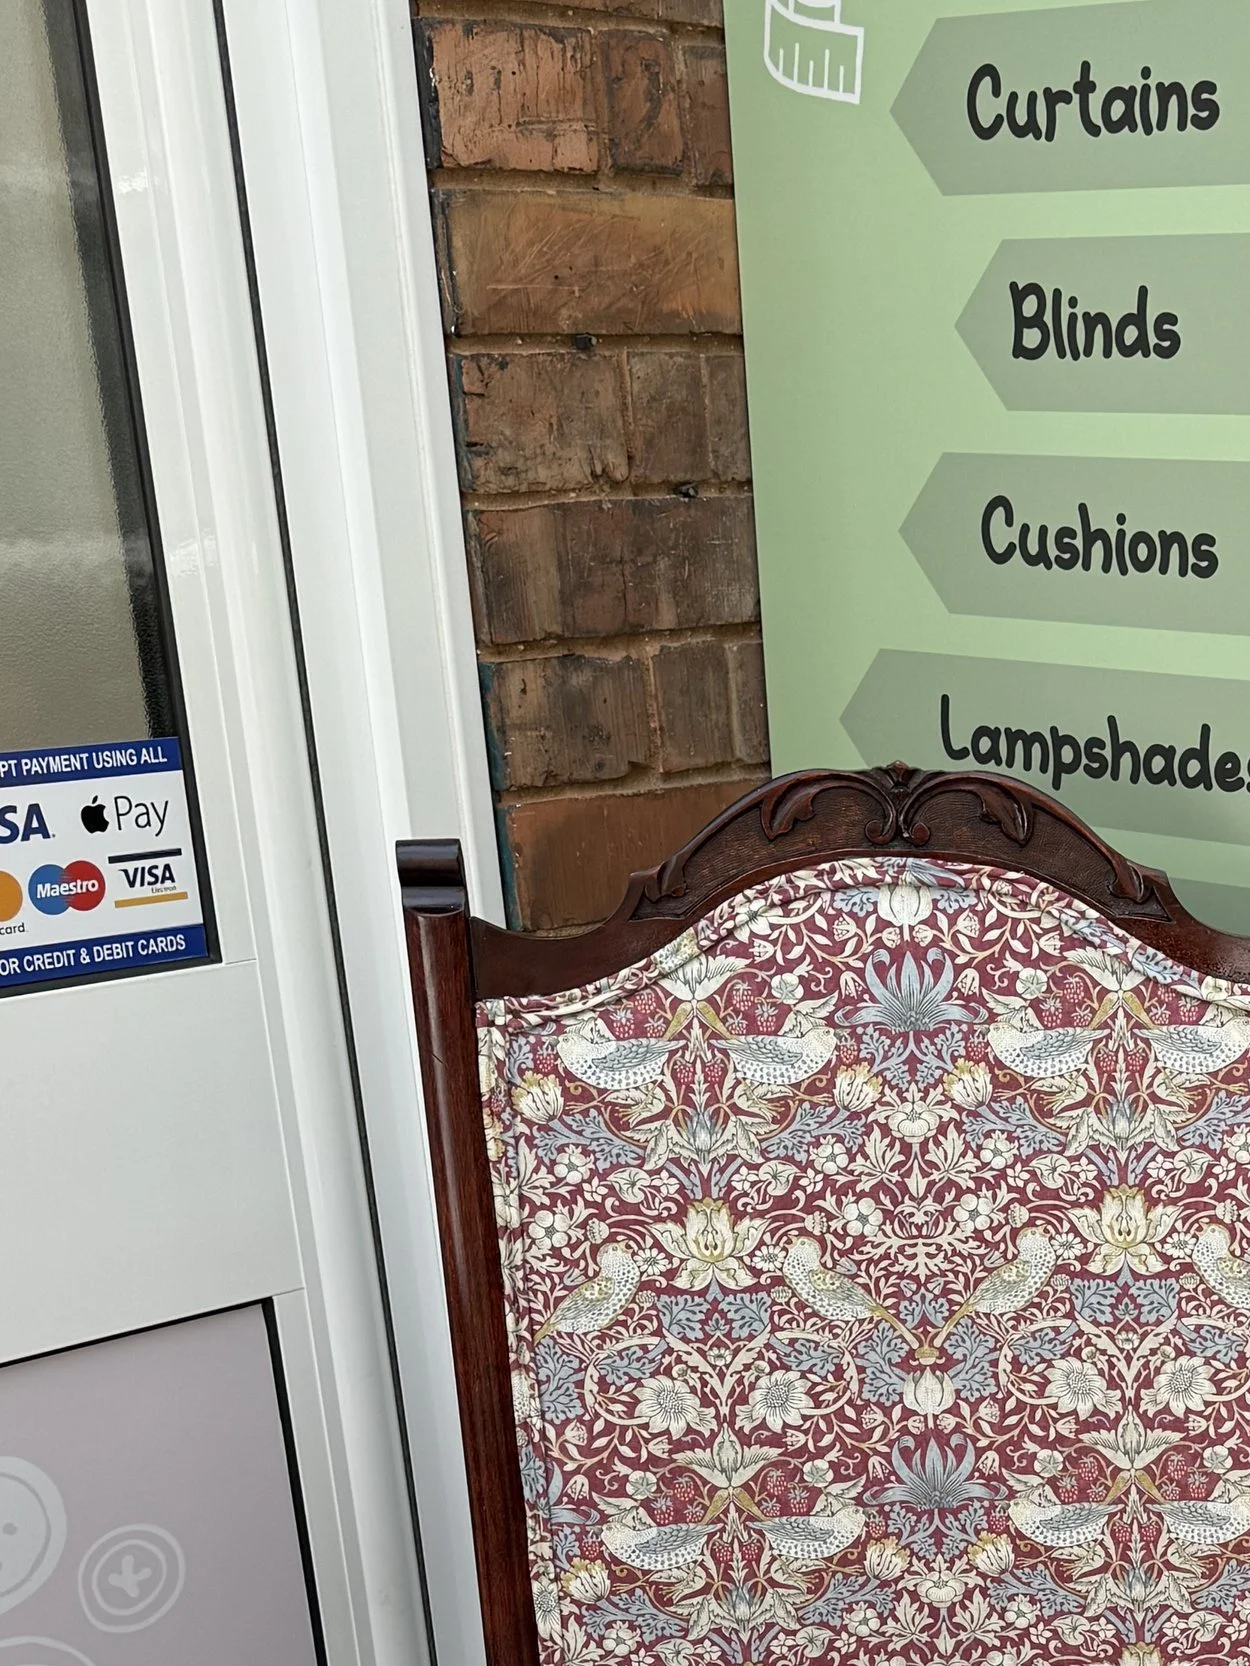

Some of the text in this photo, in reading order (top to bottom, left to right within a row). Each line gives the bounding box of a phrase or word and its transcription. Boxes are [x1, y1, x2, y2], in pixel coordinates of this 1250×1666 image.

[966, 60, 1220, 143] Curtains
[1009, 281, 1181, 362] Blinds
[981, 495, 1219, 579] Cushions
[21, 753, 89, 776] PAYMENT
[93, 748, 137, 769] USING
[140, 746, 168, 764] ALL
[114, 795, 169, 837] Pay
[37, 879, 99, 899] Maestro
[118, 863, 176, 888] VISA
[23, 949, 76, 972] CREDIT
[80, 947, 91, 964] &
[93, 941, 135, 962] DEBIT
[138, 934, 186, 953] CARDS
